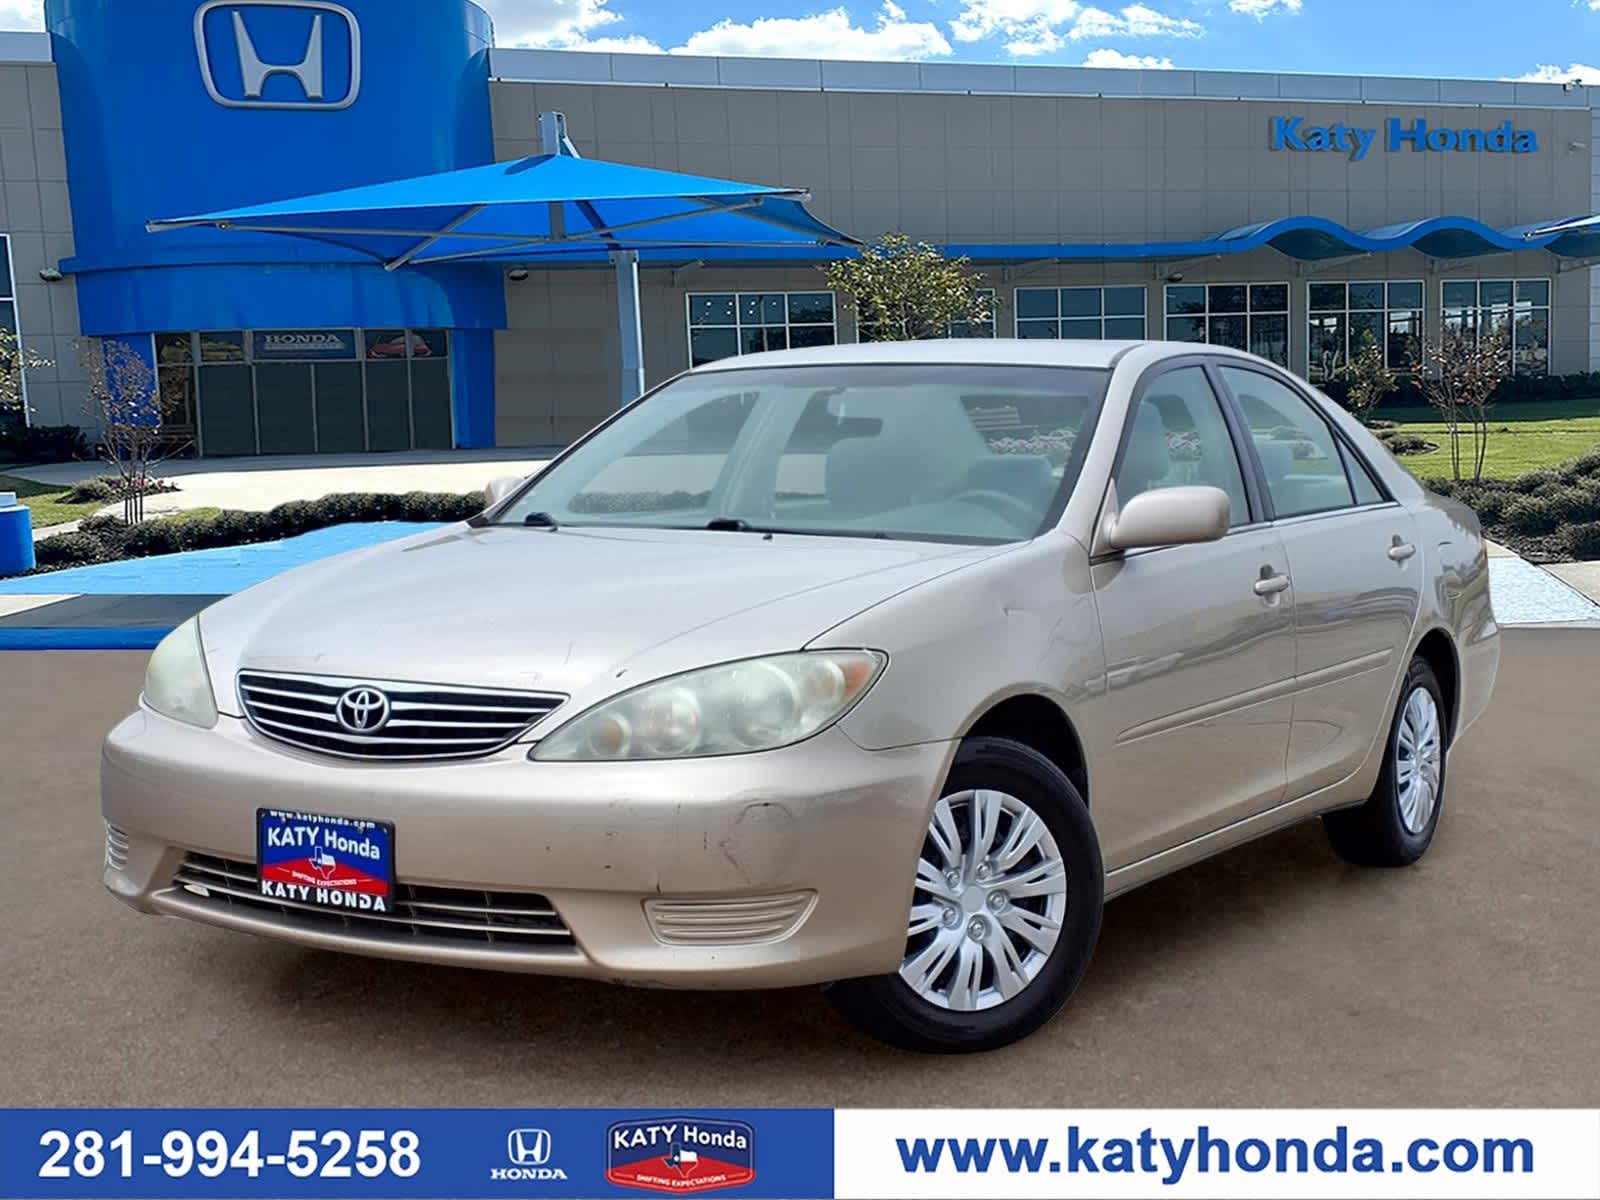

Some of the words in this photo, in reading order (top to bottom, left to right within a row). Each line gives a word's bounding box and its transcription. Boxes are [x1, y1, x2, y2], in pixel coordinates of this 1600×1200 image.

[1270, 115, 1376, 161] Katy
[1385, 117, 1539, 153] Honda
[264, 334, 342, 344] HONDA
[267, 826, 320, 847] KATY
[324, 828, 381, 860] Honda
[262, 880, 309, 901] KATY
[316, 887, 386, 912] HONDA
